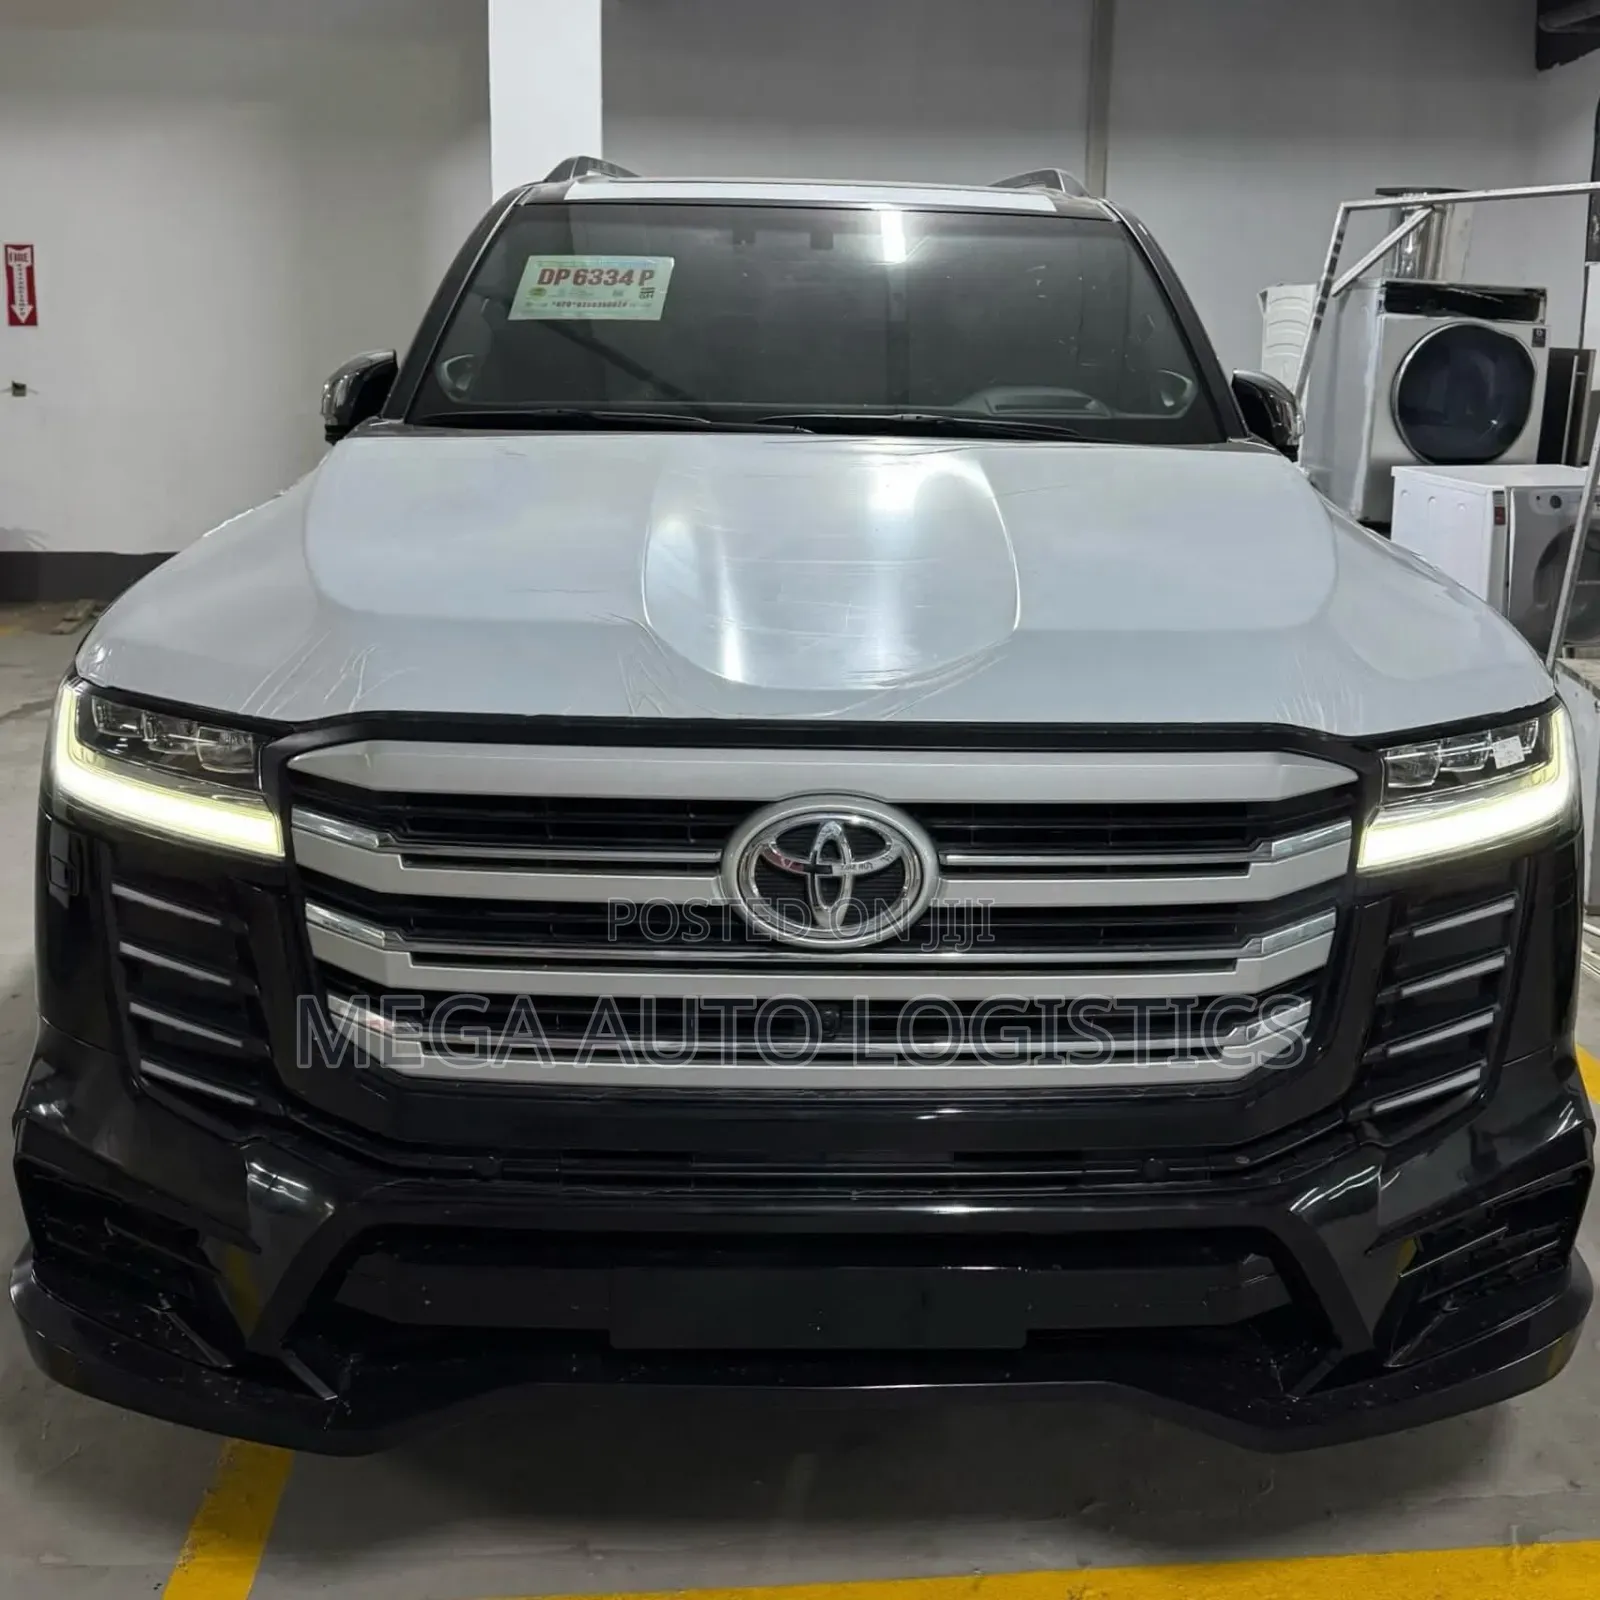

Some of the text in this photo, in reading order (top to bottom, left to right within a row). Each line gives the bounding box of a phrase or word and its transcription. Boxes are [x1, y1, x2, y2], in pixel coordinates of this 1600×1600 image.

[537, 268, 655, 287] DP 6334 P
